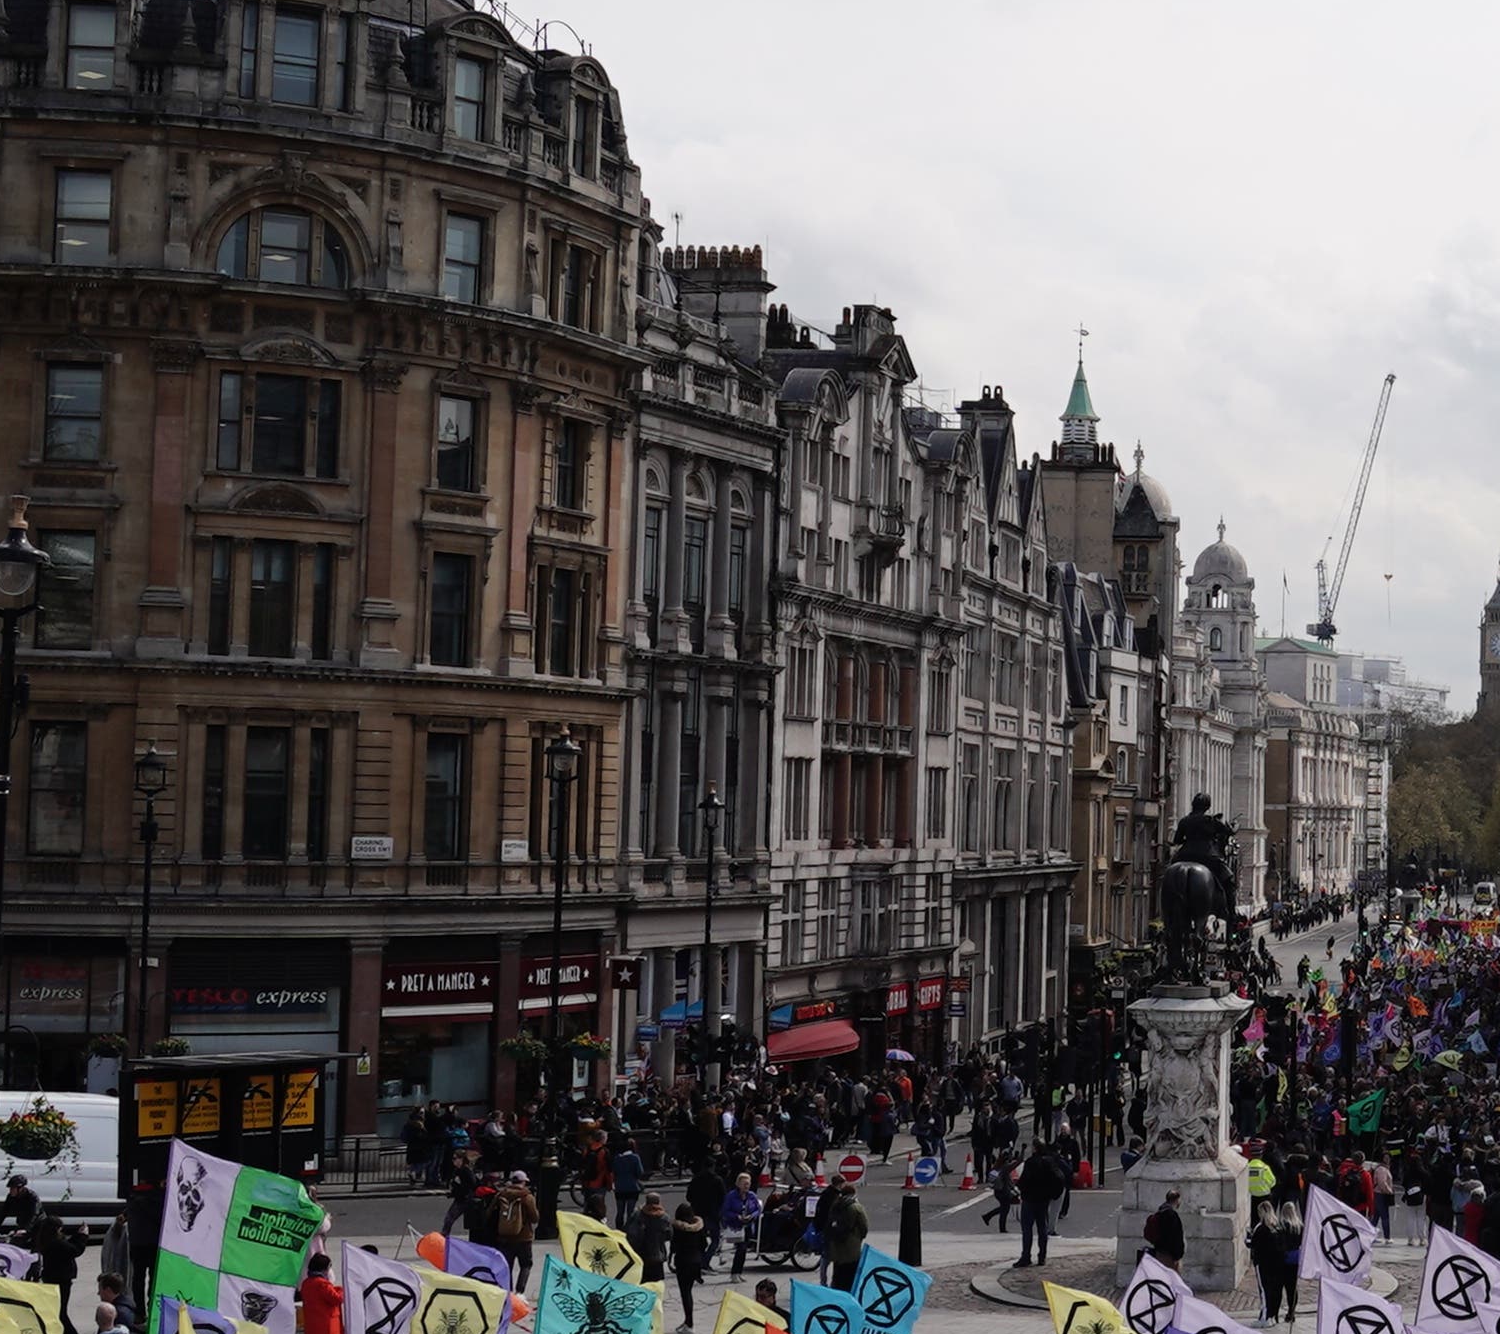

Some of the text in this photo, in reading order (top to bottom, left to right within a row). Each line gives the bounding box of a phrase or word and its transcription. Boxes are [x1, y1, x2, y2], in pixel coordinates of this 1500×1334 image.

[400, 971, 476, 993] PRET A MANGER
[20, 985, 83, 1002] express
[256, 988, 328, 1007] express
[919, 984, 942, 1007] GIFTS
